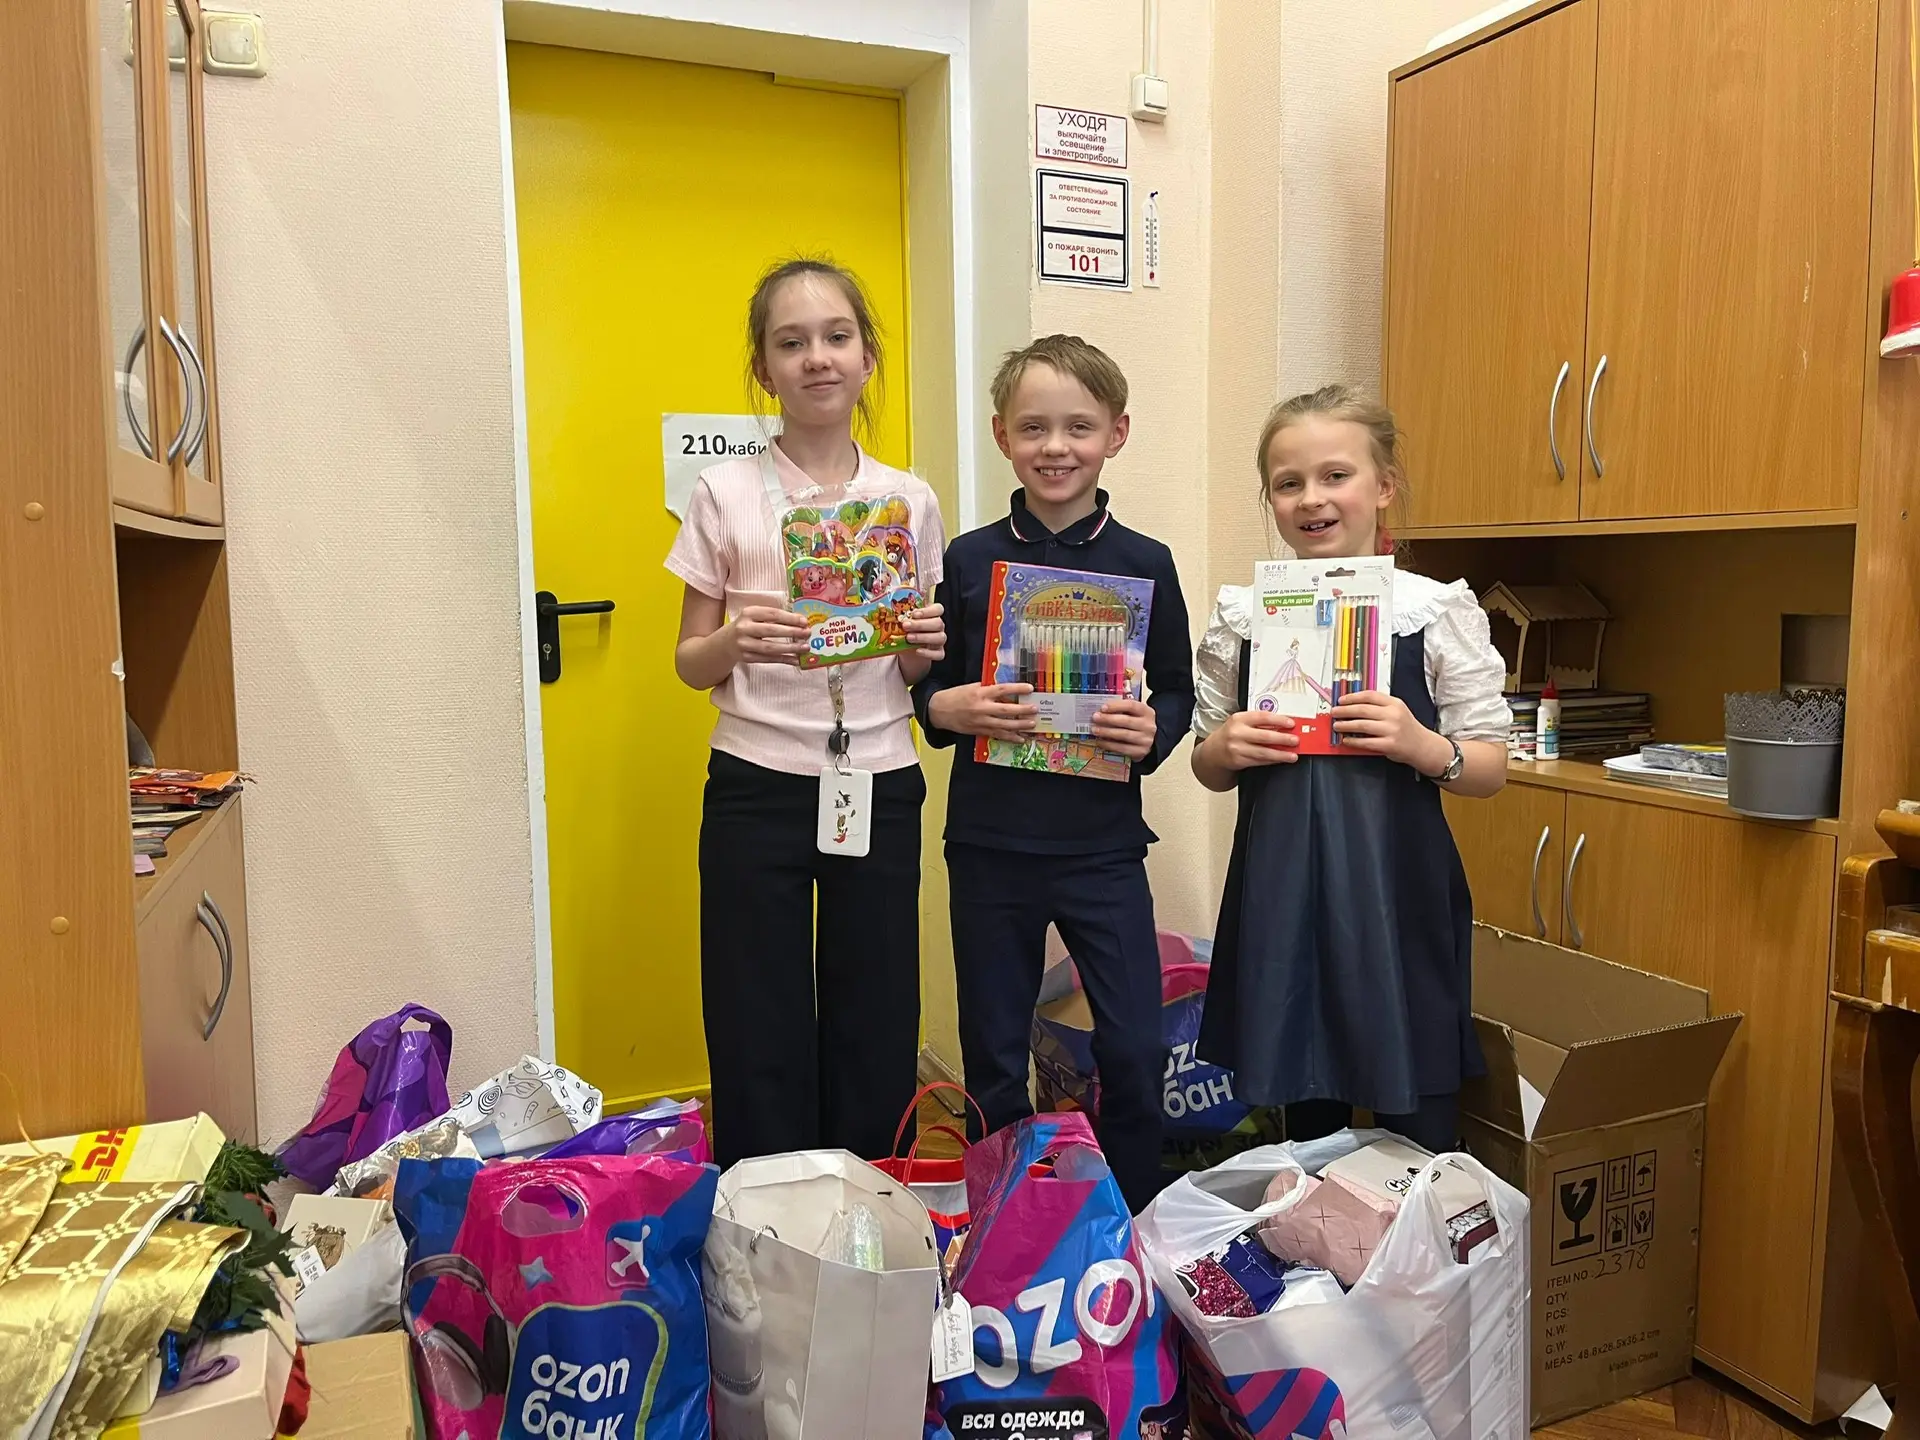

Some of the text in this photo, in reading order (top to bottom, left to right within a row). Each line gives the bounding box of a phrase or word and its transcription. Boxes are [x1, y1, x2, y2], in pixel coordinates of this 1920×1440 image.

[1058, 111, 1107, 132] УХОДЯ
[1057, 130, 1107, 144] выключайте
[1060, 139, 1105, 153] освещение
[1045, 147, 1119, 165] и электроприборы
[1058, 184, 1109, 196] ОТВЕТСТВЕННЫЙ
[1058, 195, 1118, 208] ПРОТИВОПОЖАРНОЕ
[1066, 206, 1101, 215] СОСТОЯНИЕ
[1048, 242, 1119, 256] О ПОЖАРЕ ЗВОНИТЬ
[1069, 254, 1099, 273] 101
[819, 624, 857, 636] большая
[829, 619, 845, 628] моя
[811, 630, 868, 650] ФЕРМА
[1163, 1072, 1234, 1118] бан
[1593, 1242, 1650, 1280] 2378
[1547, 1274, 1571, 1288] ITEM
[531, 1354, 630, 1402] ozon
[961, 1409, 1085, 1431] вся одежда
